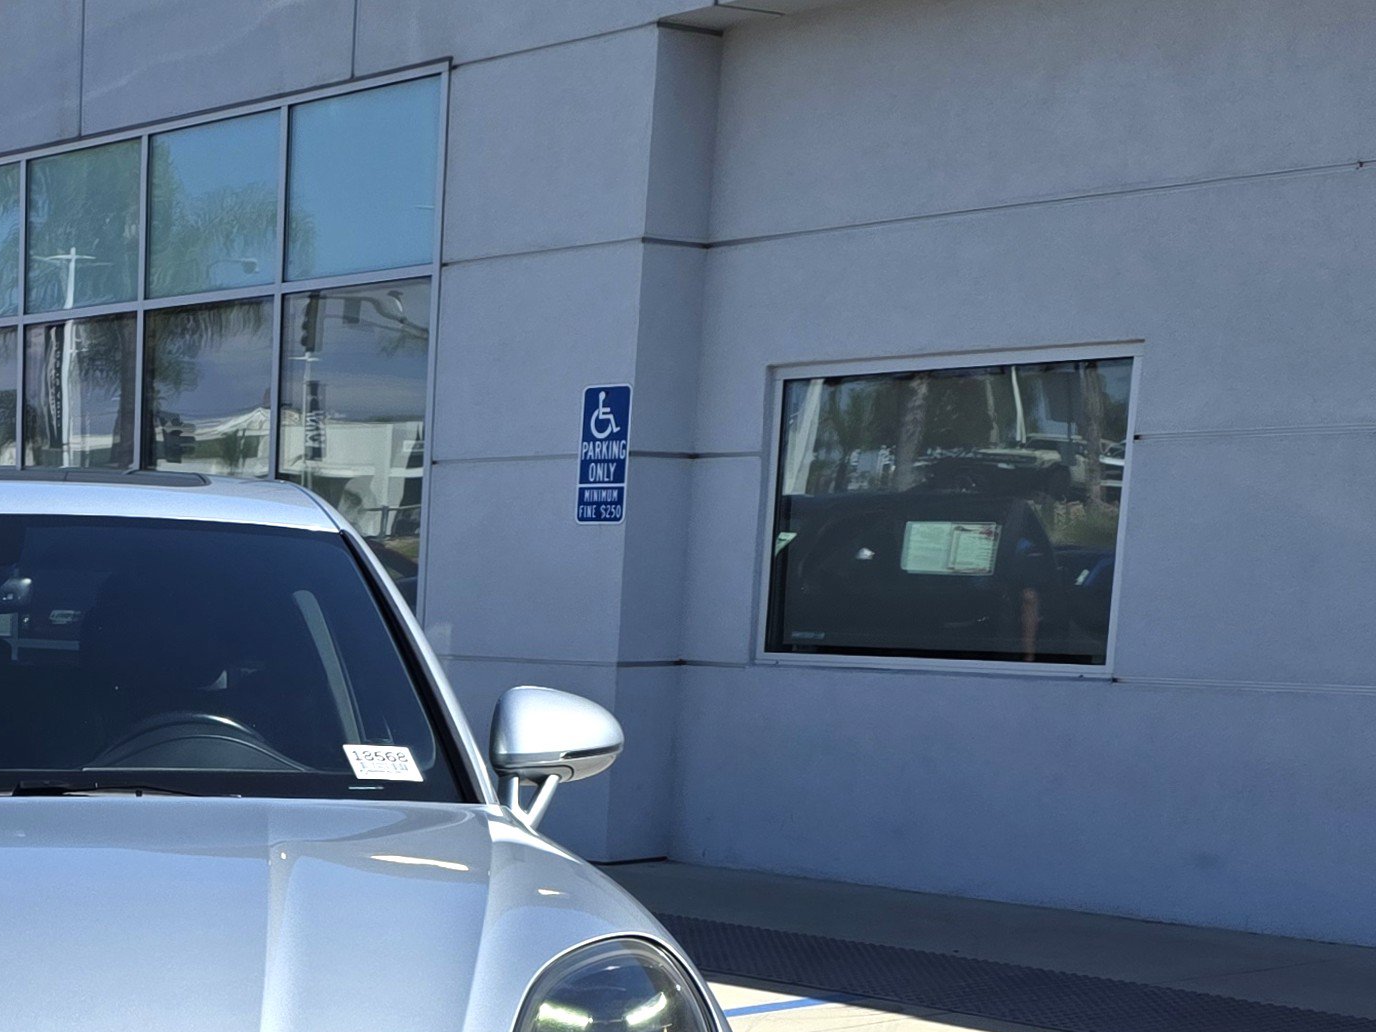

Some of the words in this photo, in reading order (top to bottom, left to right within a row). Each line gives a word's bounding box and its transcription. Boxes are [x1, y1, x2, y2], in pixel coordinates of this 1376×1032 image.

[581, 440, 626, 460] PARKING
[588, 463, 616, 482] ONLY
[584, 489, 618, 502] MINIMUM
[579, 505, 596, 518] FINE
[600, 505, 621, 518] $250
